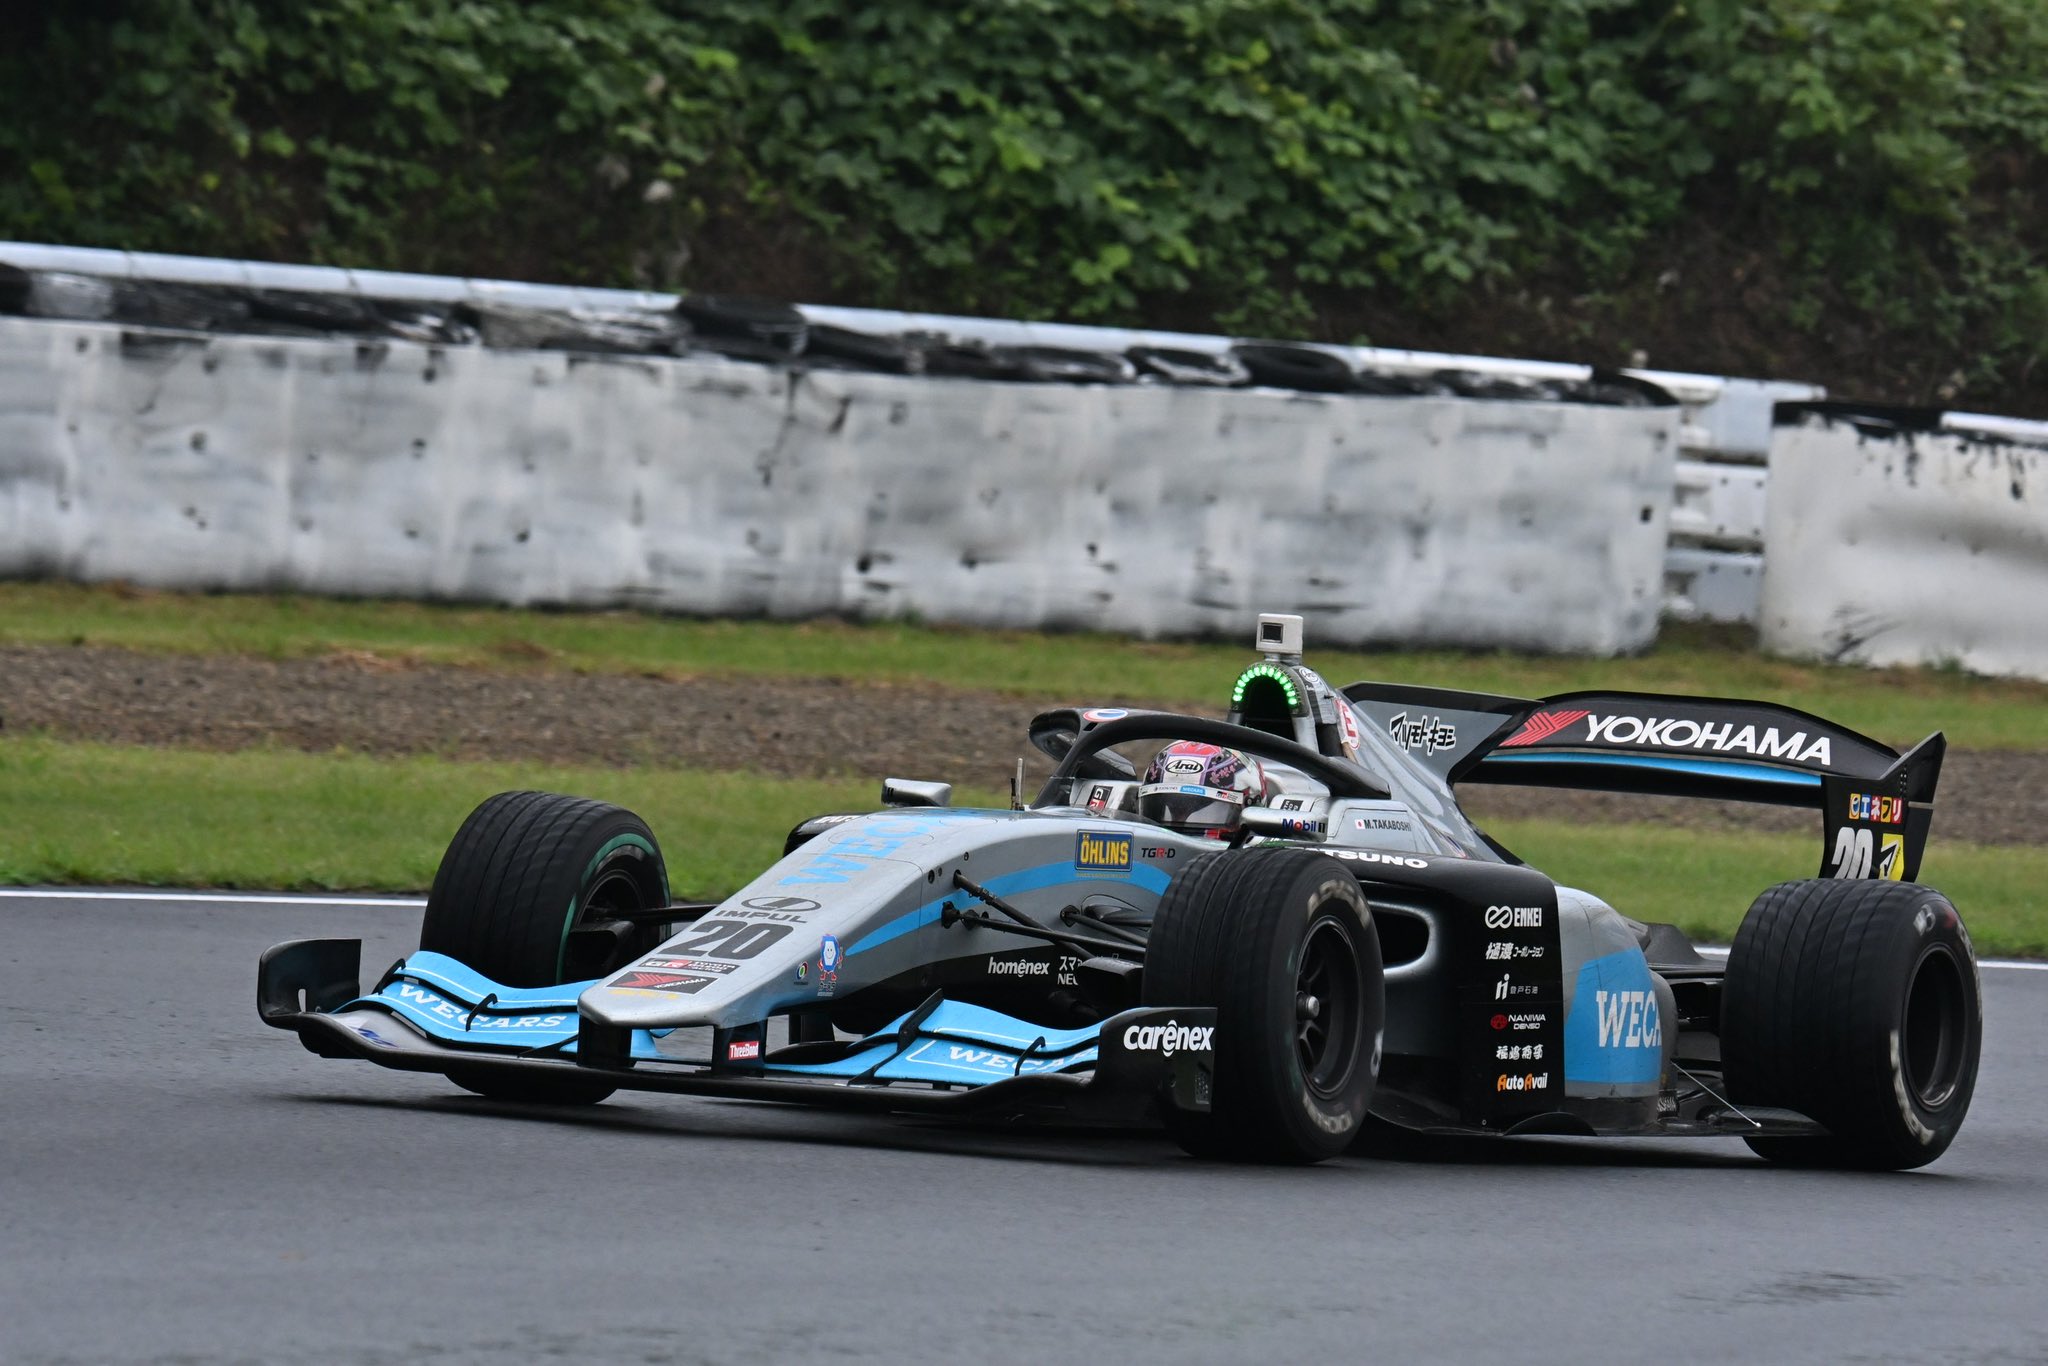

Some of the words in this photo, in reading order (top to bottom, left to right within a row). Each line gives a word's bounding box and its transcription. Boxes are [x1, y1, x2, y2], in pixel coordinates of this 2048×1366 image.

[1585, 714, 1831, 765] YOKOHAMA
[1171, 760, 1199, 771] Arai
[1282, 818, 1317, 833] Mobil
[1364, 819, 1411, 832] M.TAKABOSHI
[1080, 834, 1129, 865] ÖHLINS
[714, 910, 808, 924] IMPUL
[1514, 907, 1542, 927] ENKEI
[656, 919, 794, 960] 20
[653, 978, 708, 989] YOKOHAMA
[400, 983, 567, 1028] WECARS
[1508, 1014, 1546, 1022] NANIWA
[1513, 1022, 1541, 1030] DENSO
[729, 1042, 759, 1059] ThreeBond
